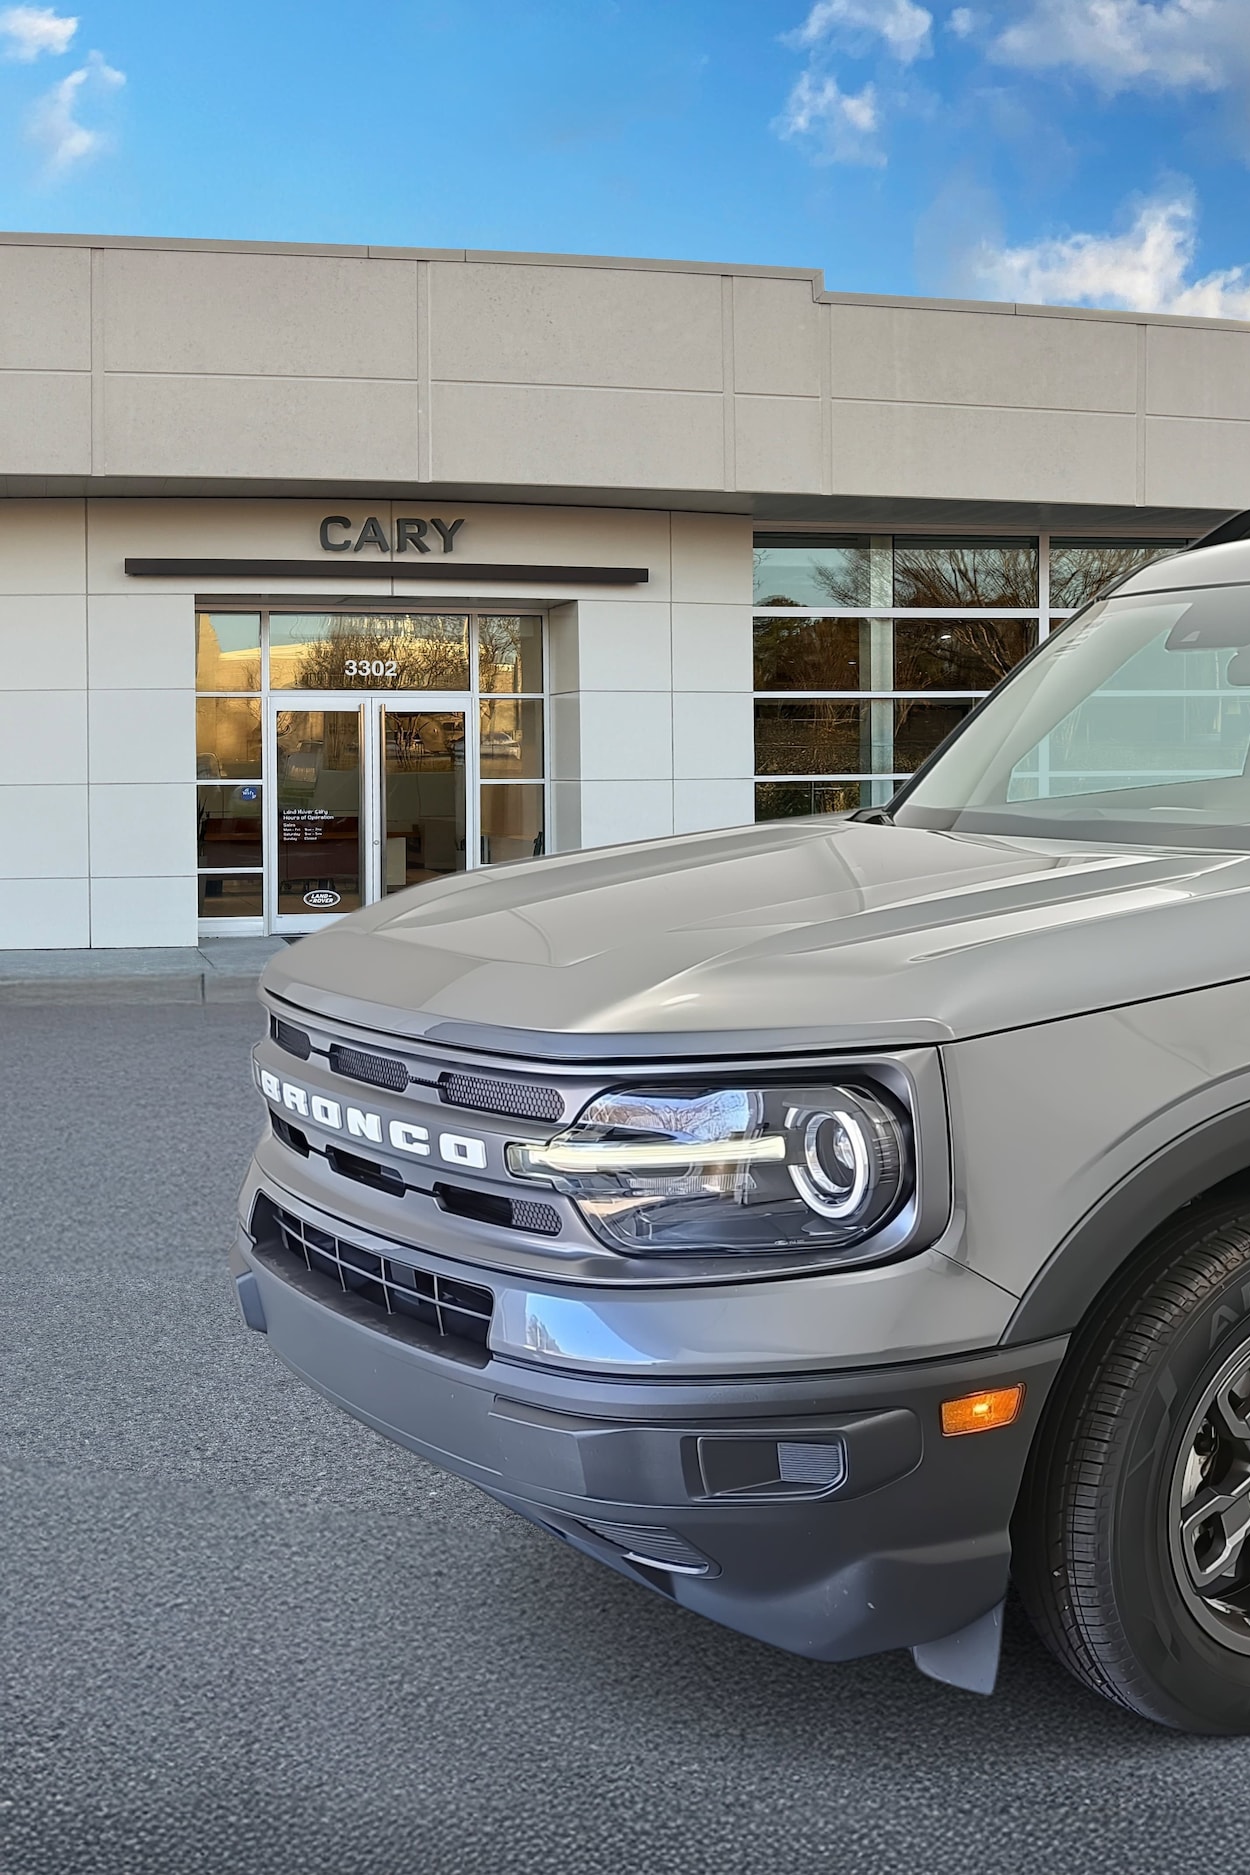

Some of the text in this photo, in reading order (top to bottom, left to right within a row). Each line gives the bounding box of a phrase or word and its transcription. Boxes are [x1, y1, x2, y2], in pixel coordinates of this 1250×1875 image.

[318, 514, 466, 554] CARY
[344, 658, 398, 678] 3302
[260, 1069, 488, 1170] BRONCO
